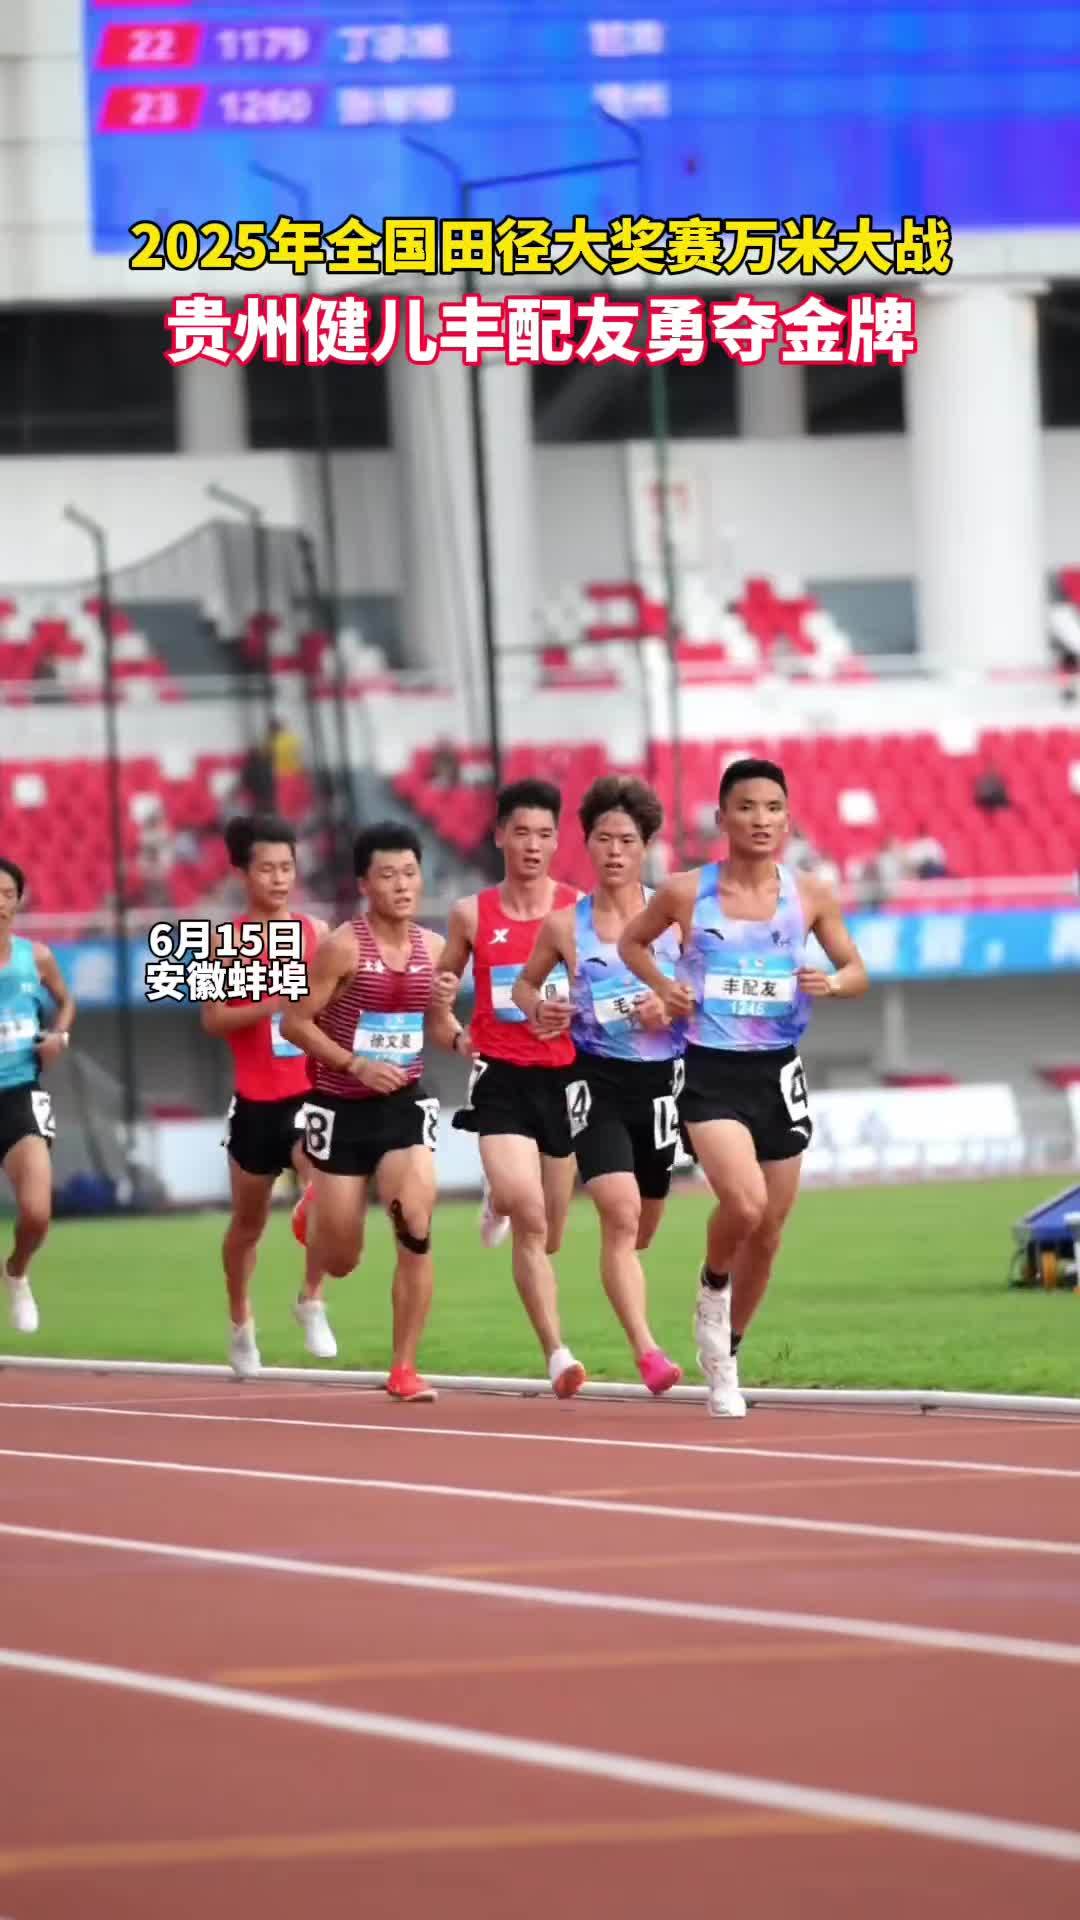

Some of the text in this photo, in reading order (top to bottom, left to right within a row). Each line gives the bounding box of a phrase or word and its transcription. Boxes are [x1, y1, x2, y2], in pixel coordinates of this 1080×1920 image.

[127, 28, 176, 63] 22
[129, 91, 179, 125] 23
[722, 977, 777, 997] 丰配友
[571, 1084, 587, 1125] 4
[306, 1111, 328, 1152] 8
